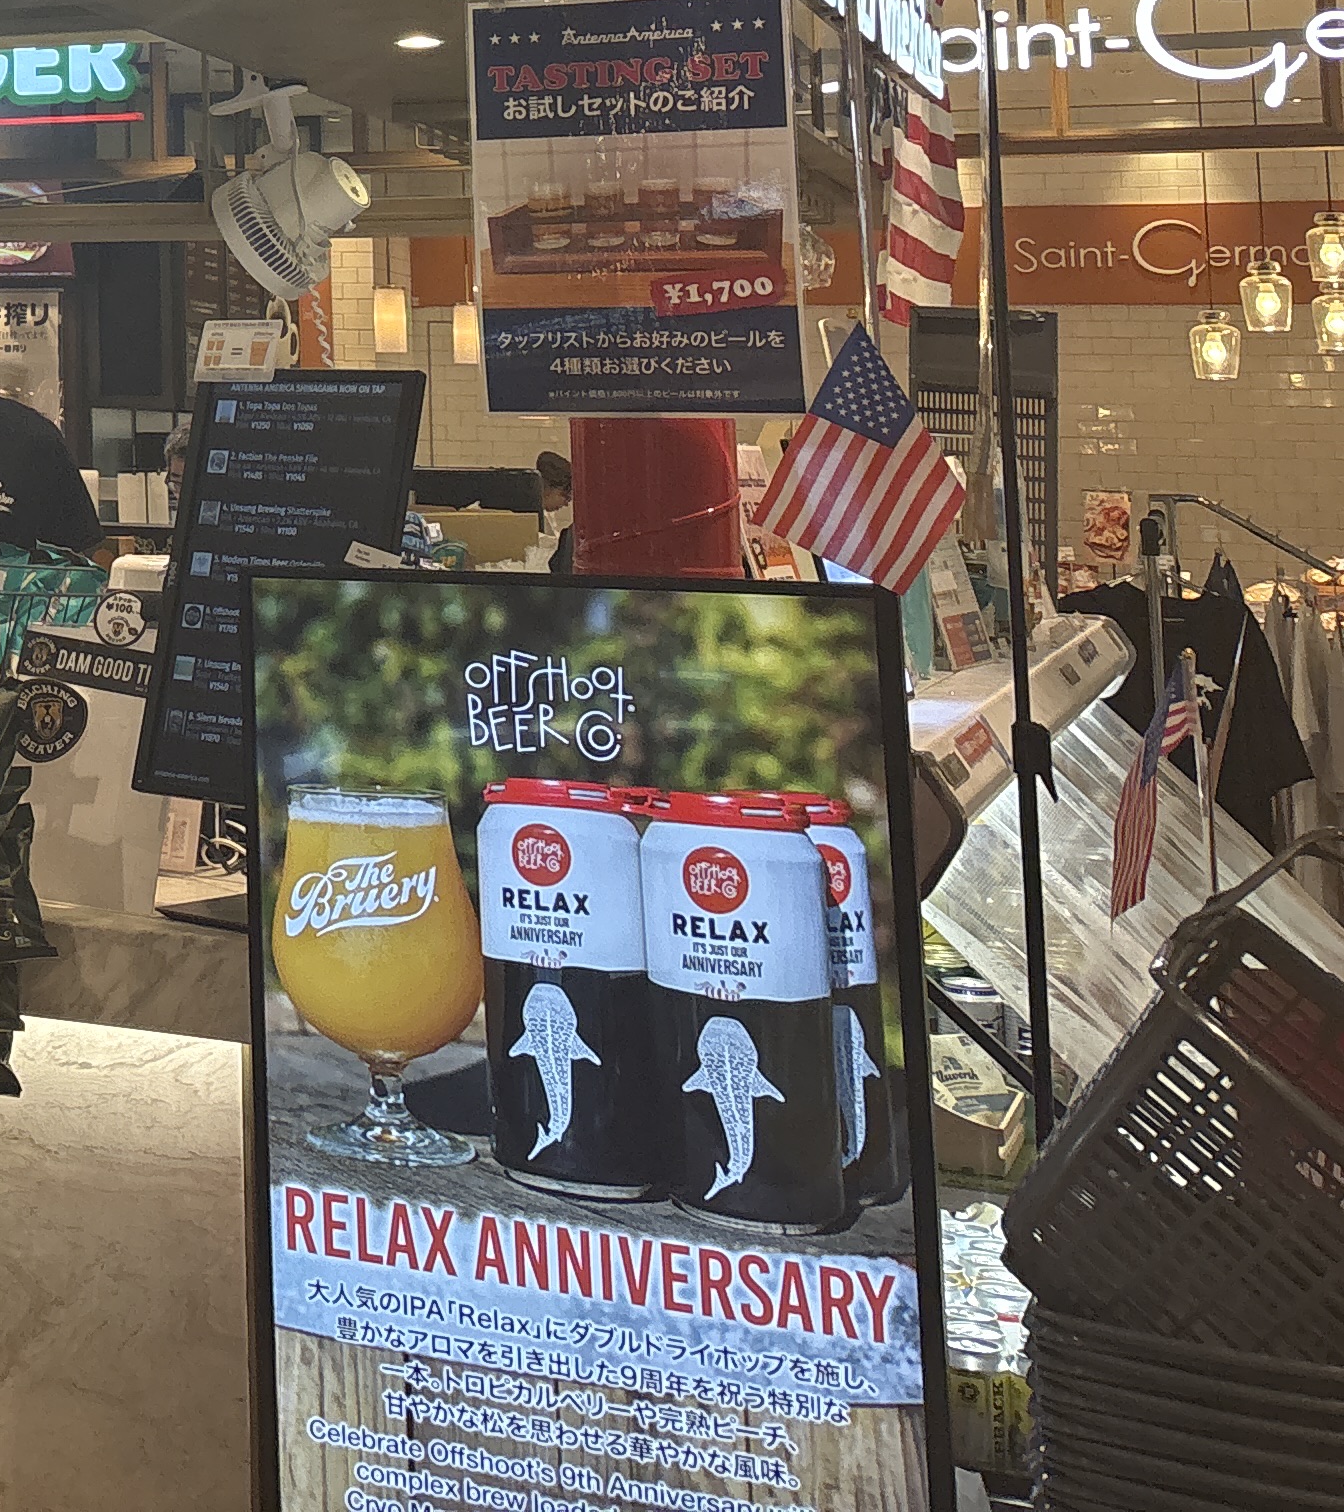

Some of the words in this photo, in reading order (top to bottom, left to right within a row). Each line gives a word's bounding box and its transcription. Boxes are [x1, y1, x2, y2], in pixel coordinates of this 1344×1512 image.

[488, 57, 673, 93] TASTING
[688, 51, 769, 82] SET
[503, 85, 755, 120] お試しセットのご紹介
[663, 276, 774, 305] ¥1,700
[497, 329, 786, 349] タップリストからお好みのビールを
[550, 357, 733, 376] 4種類お選びください
[56, 649, 92, 675] DAM
[92, 655, 134, 683] GOOD
[17, 684, 79, 711] BELCHING
[19, 731, 75, 755] BEAVER
[328, 850, 398, 891] The
[501, 887, 590, 916] RELAX
[510, 925, 584, 948] ANNIVERSARY
[672, 913, 770, 945] RELAX
[682, 954, 764, 980] ANNIVERSARY
[284, 1185, 456, 1278] RELAX
[474, 1215, 896, 1345] ANNIVERSARY
[336, 1315, 850, 1426] 豊かなアロマを引き出した9周年を祝う特別な
[381, 1361, 799, 1455] 一本。トロピカルベリーや完熟ピーチ、
[384, 1392, 800, 1491] 甘やかな松を思わせる華やかな風味。
[309, 1419, 424, 1460] Celebrate
[429, 1440, 556, 1486] Offshoot's
[561, 1464, 603, 1494] 9th
[609, 1474, 763, 1512] Anniversary
[355, 1463, 461, 1502] complex
[465, 1480, 526, 1511] brew
